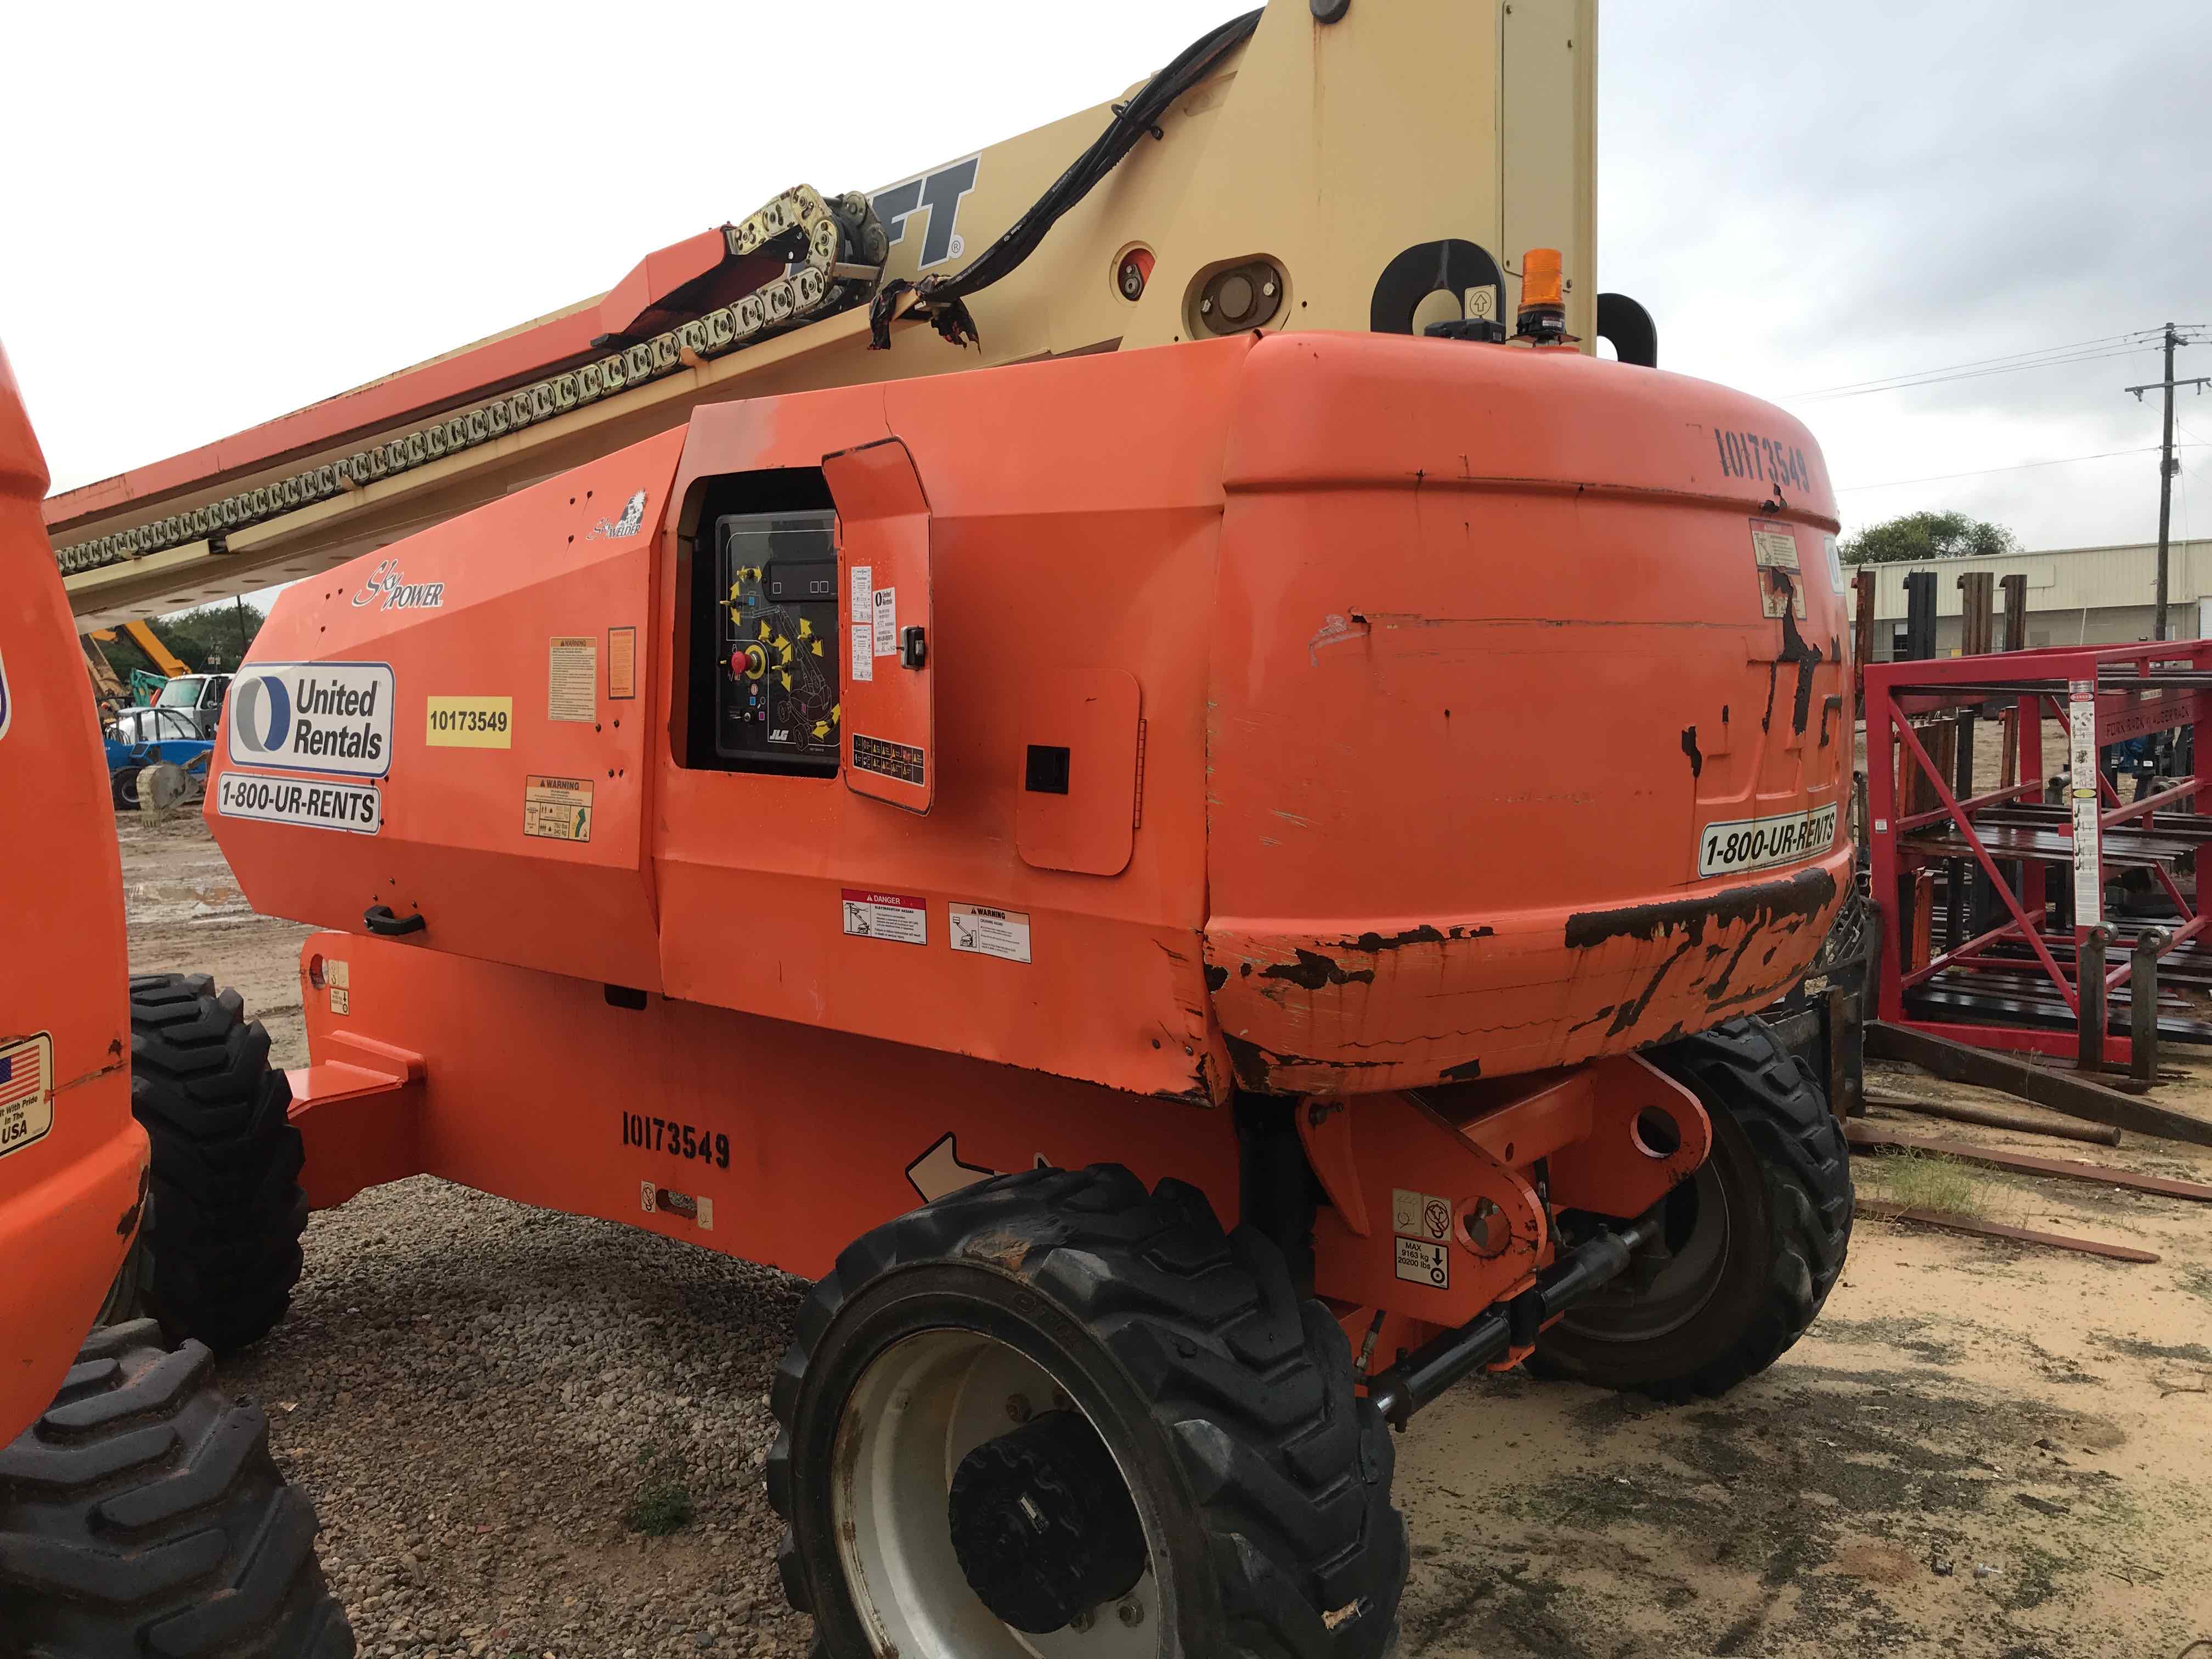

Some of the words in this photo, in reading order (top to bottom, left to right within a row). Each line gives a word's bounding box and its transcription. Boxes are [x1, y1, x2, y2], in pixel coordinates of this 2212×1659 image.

[1714, 428, 1809, 493] 10173549
[353, 559, 404, 611] Sky
[389, 583, 444, 607] POWER
[297, 679, 377, 716] United
[431, 710, 507, 732] 10173549
[294, 719, 382, 760] Rentals
[769, 729, 789, 741] JLG
[546, 779, 580, 791] WARNING
[223, 781, 375, 823] 1-800-UR-RENTS
[1707, 812, 1835, 866] 1-800-UR-RENTS
[873, 895, 900, 905] DANGER
[978, 908, 1006, 919] WARNING
[6, 1102, 20, 1114] With
[22, 1096, 38, 1108] Pride
[4, 1117, 11, 1125] In
[13, 1111, 24, 1121] The
[2, 1119, 27, 1144] USA
[623, 1111, 730, 1169] 10173549
[1402, 1250, 1419, 1259] 9163
[1420, 1253, 1429, 1262] kg
[1405, 1242, 1422, 1251] MAX
[1398, 1257, 1419, 1266] 20200
[1420, 1261, 1431, 1269] lbs
